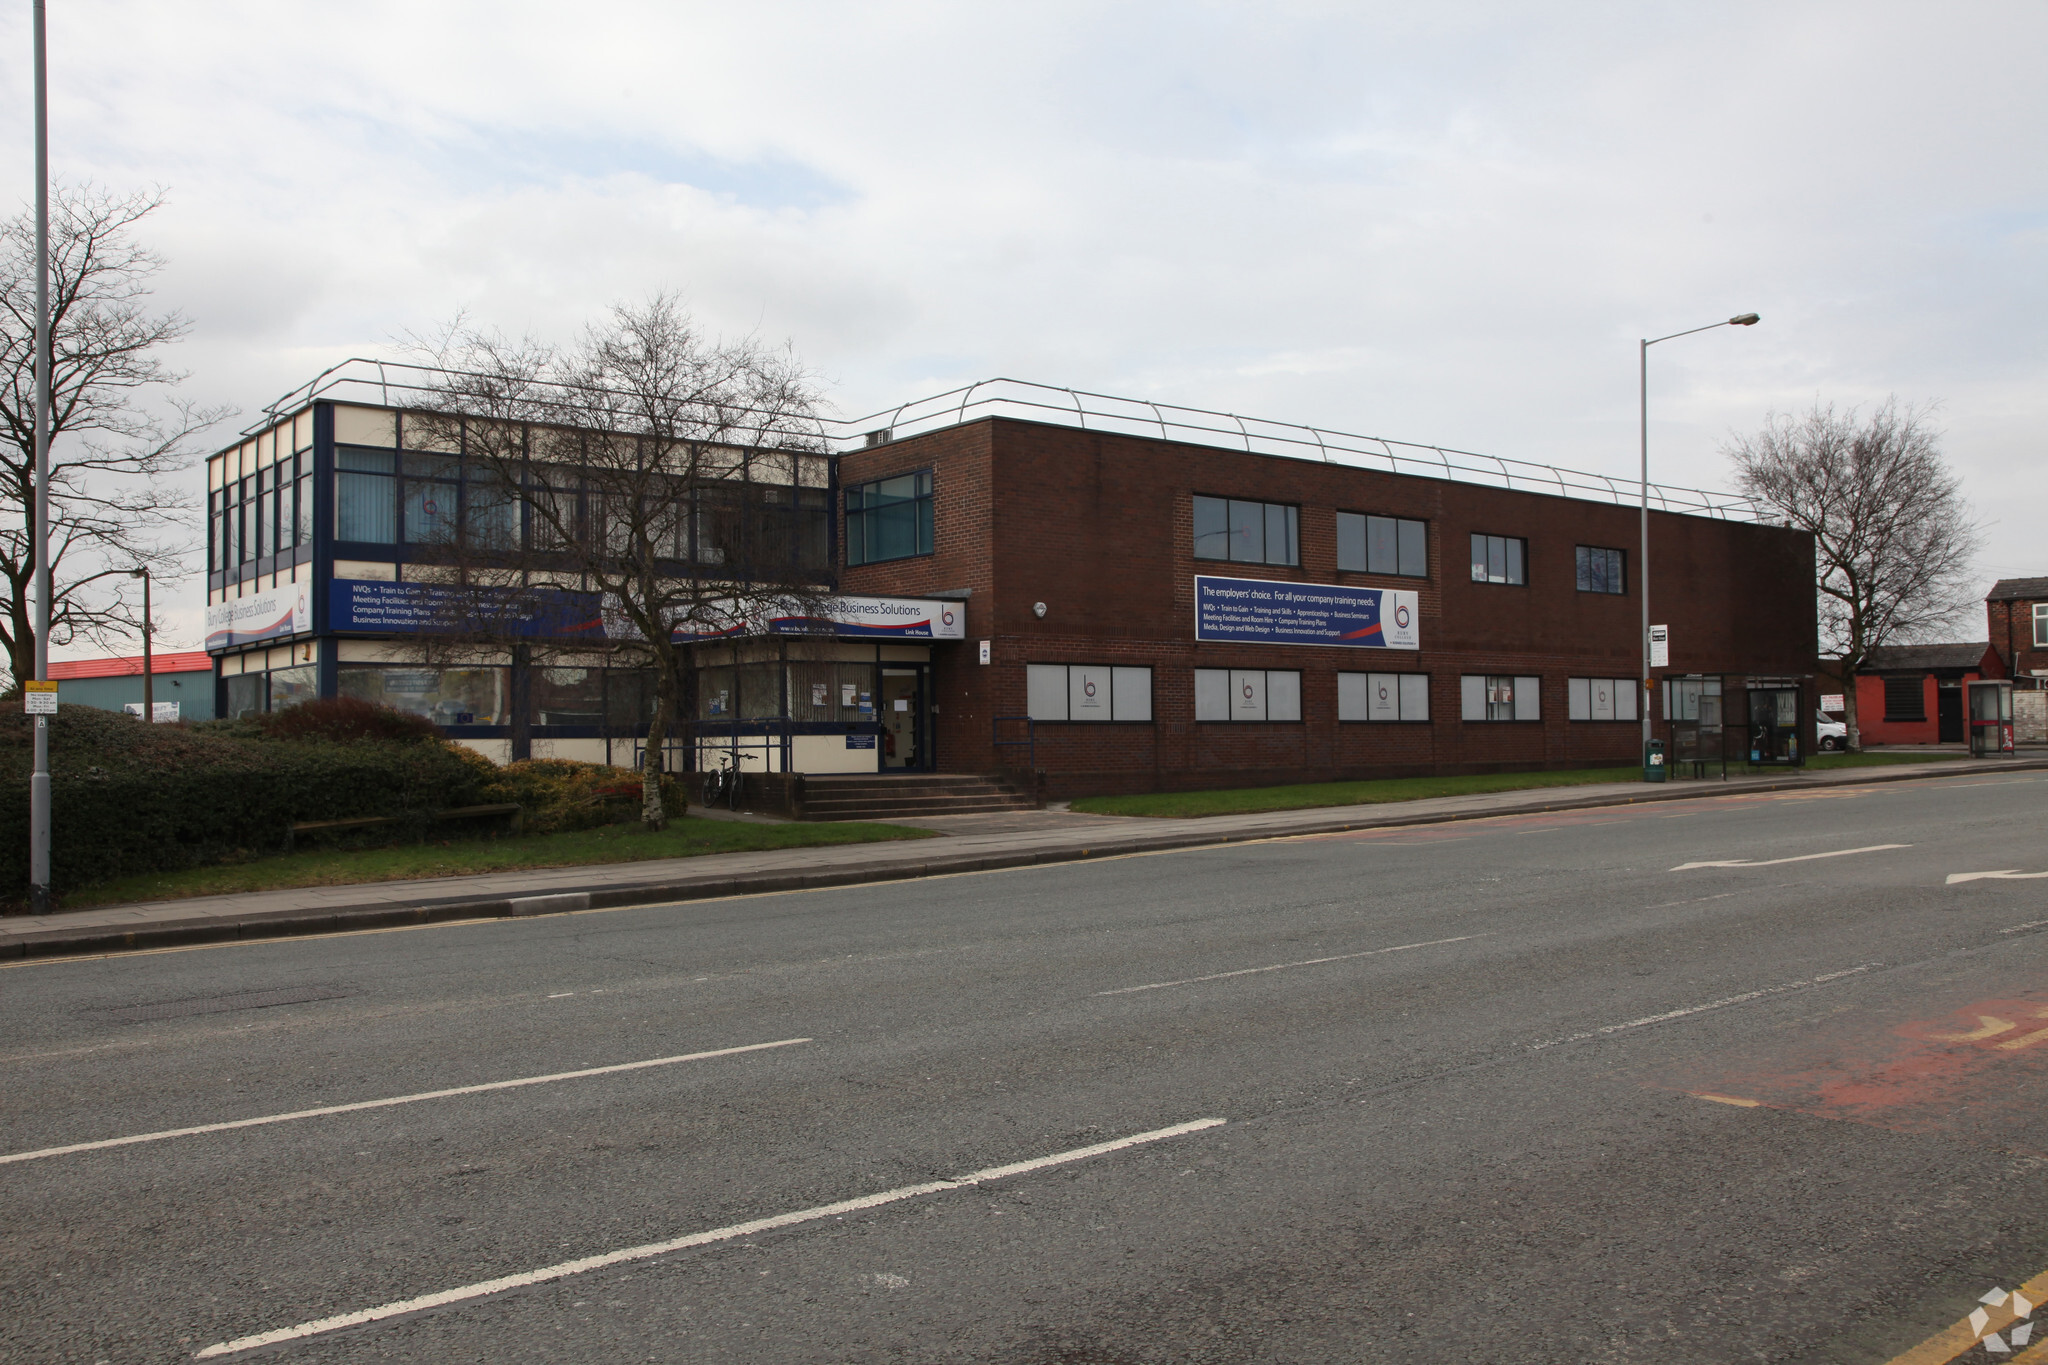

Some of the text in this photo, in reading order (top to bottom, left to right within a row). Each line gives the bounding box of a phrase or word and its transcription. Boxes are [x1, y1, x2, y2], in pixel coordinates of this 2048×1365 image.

[353, 585, 371, 593] NVQs
[380, 586, 396, 594] Train
[397, 587, 404, 595] to
[1203, 586, 1215, 597] The
[1251, 590, 1272, 600] choice.
[1274, 591, 1284, 600] For
[1285, 592, 1293, 601] all
[1293, 595, 1306, 603] your
[1307, 595, 1334, 605] company
[1334, 596, 1356, 607] training
[1357, 598, 1375, 606] needs.
[353, 595, 381, 605] Meeting
[208, 598, 276, 629] Bury College Business Solutions
[353, 605, 385, 615] Company
[385, 606, 412, 617] Training
[413, 608, 431, 616] Plans
[840, 601, 879, 615] Business
[880, 602, 921, 616] Solutions
[1221, 604, 1232, 612] Train
[1238, 605, 1249, 613] Gain
[1254, 606, 1271, 615] Training
[1297, 609, 1330, 618] Apprenticeships
[1334, 611, 1351, 619] Business
[353, 615, 382, 624] Business
[383, 616, 418, 625] Innovation
[1203, 613, 1222, 622] Meeting
[1223, 614, 1241, 622] Facilities
[1264, 616, 1274, 624] Hire
[1278, 617, 1298, 626] Company
[1299, 618, 1316, 627] Training
[1203, 623, 1219, 631] Media,
[1219, 624, 1235, 632] Design
[1255, 626, 1270, 634] Design
[1275, 626, 1293, 634] Business
[1324, 629, 1341, 637] Support
[1776, 692, 1795, 708] WIN
